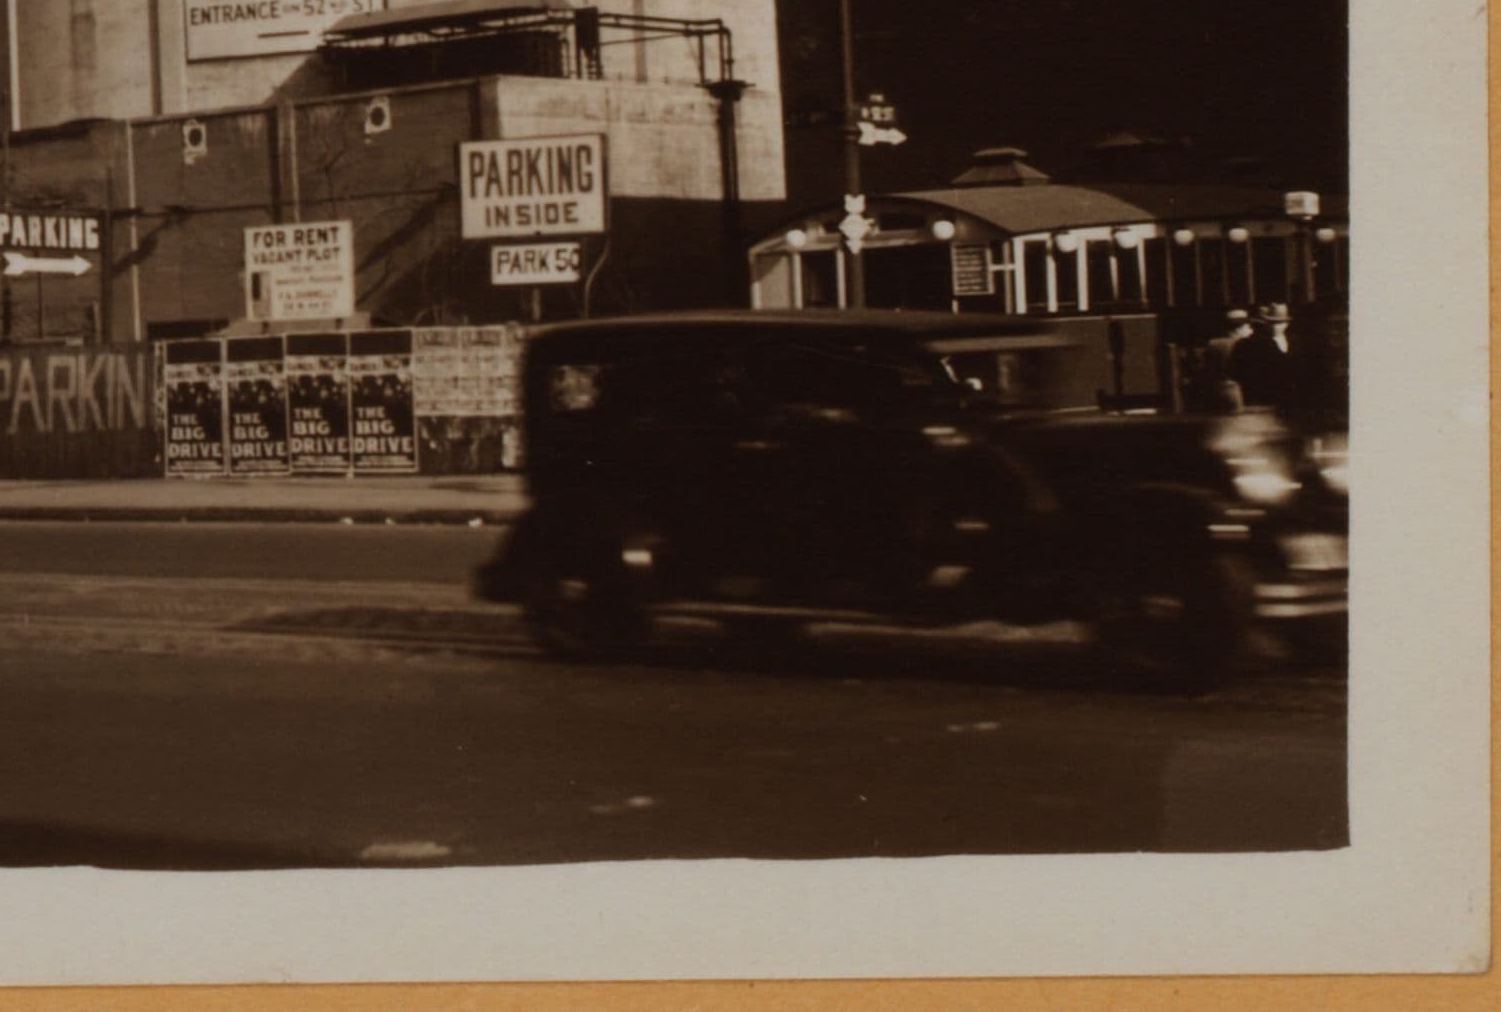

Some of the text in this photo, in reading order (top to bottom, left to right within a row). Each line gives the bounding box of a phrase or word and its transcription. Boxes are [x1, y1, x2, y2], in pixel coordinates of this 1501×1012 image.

[190, 0, 281, 27] ENTRANCE
[469, 144, 593, 199] PARKING
[485, 201, 580, 228] INSIDE
[252, 226, 339, 248] FOR RENT
[496, 249, 550, 275] PARK
[172, 413, 198, 425] THE
[234, 412, 261, 425] THE
[293, 407, 322, 420] THE
[356, 406, 385, 419] THE
[171, 426, 206, 440] BIG
[233, 425, 270, 439] BIG
[293, 419, 332, 436] BIG
[356, 419, 395, 435] BIG
[168, 442, 222, 458] DRIVE
[231, 441, 286, 458] DRIVE
[290, 437, 349, 454] DRIVE
[354, 437, 413, 454] DRIVE
